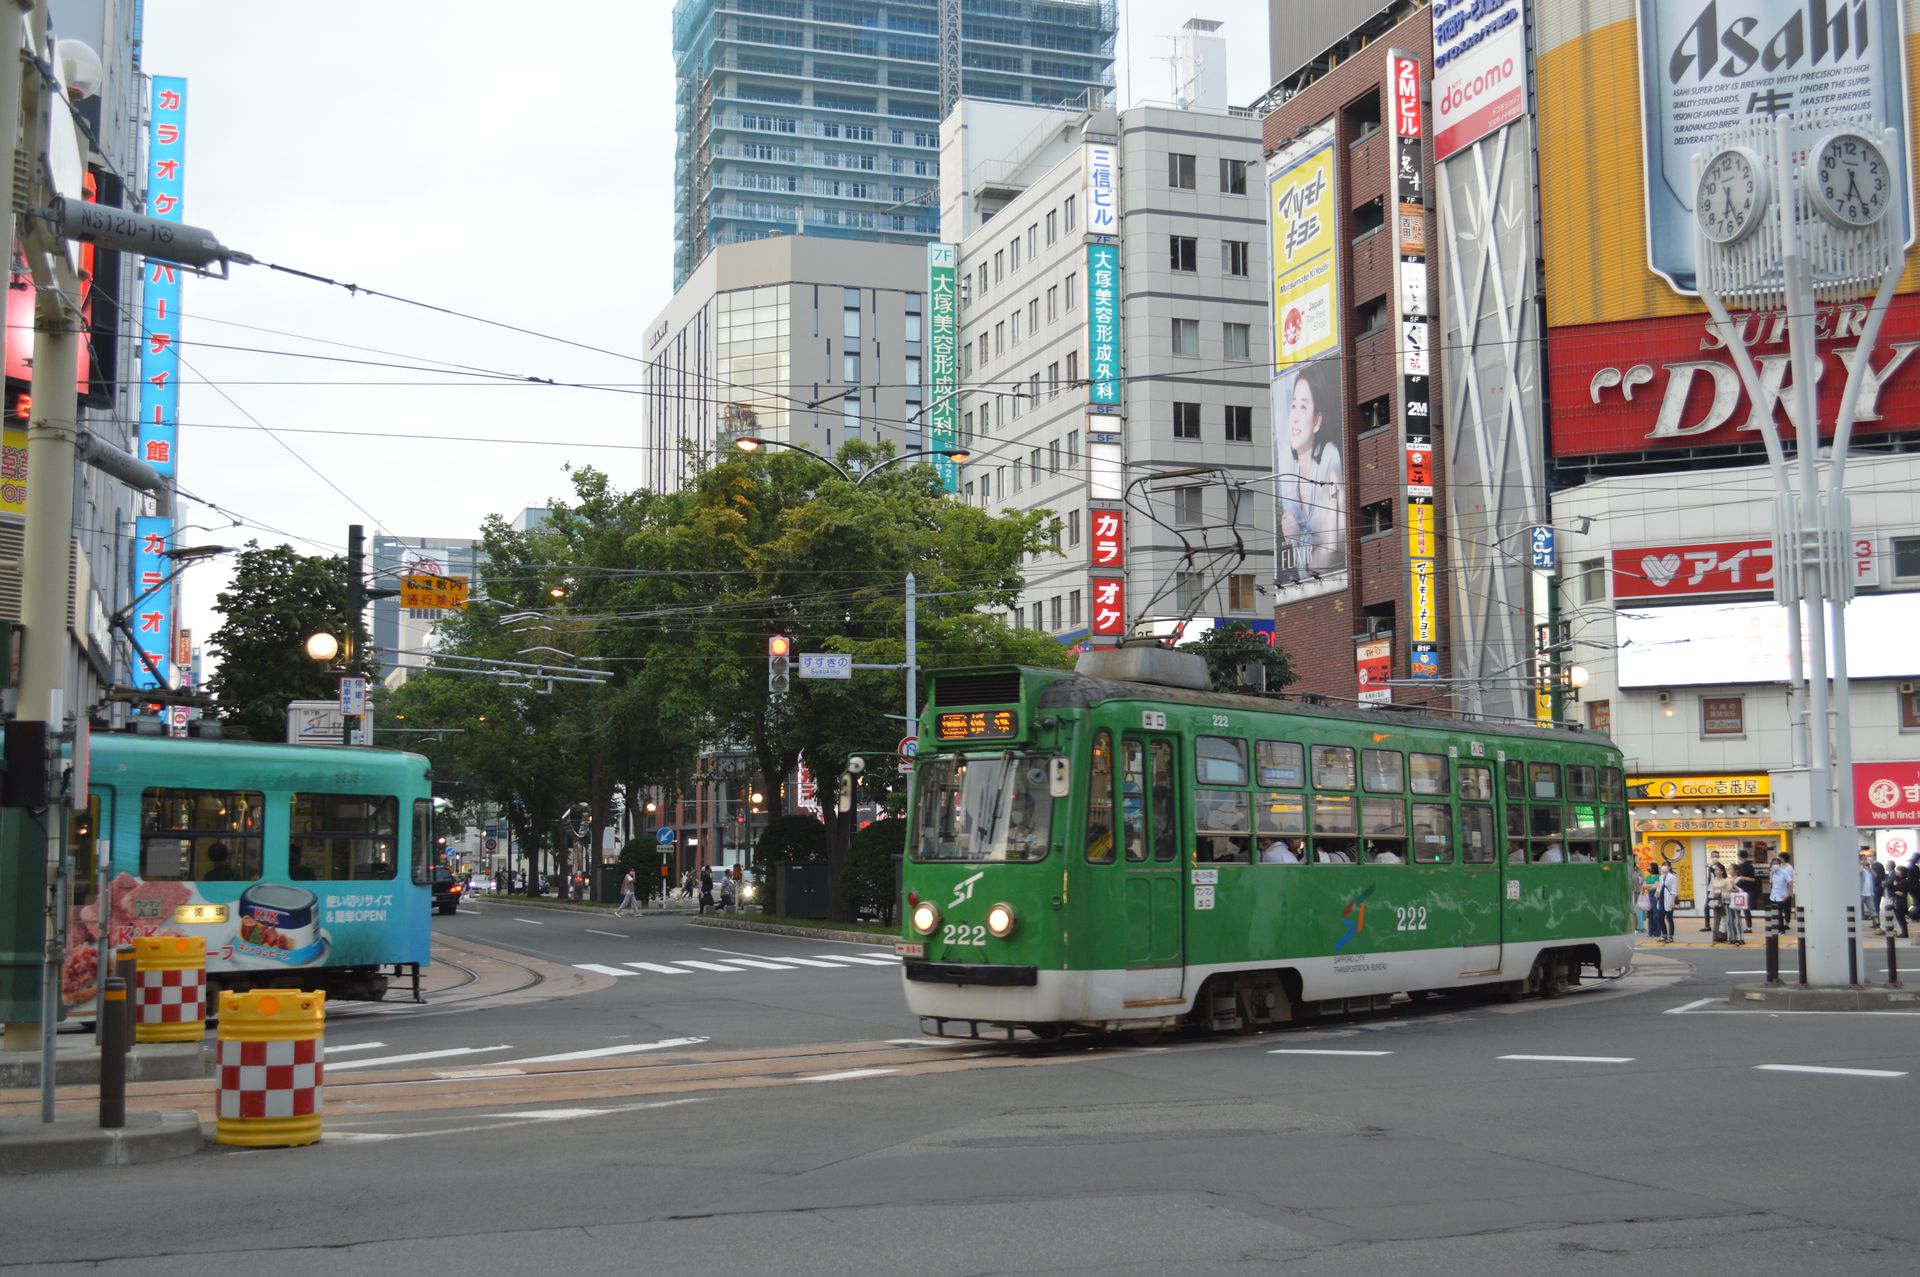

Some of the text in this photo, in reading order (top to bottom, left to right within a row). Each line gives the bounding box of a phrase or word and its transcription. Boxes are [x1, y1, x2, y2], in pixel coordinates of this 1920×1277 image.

[1669, 0, 1868, 84] Asahi
[1441, 58, 1513, 115] docomo
[1672, 88, 1690, 98] ASAHI
[1690, 84, 1712, 95] SUPER
[1714, 83, 1730, 92] DRY
[1731, 82, 1739, 90] IS
[1740, 78, 1775, 89] BREWED
[1776, 75, 1799, 85] WITH
[1800, 68, 1842, 82] PRECISION
[1843, 66, 1852, 75] TO
[1799, 82, 1829, 94] UNDER
[1830, 80, 1847, 89] THE
[1399, 60, 1418, 136] 2Mビル
[1800, 89, 1871, 106] MASTER BREWERS
[1672, 101, 1695, 109] QUALITY
[1672, 112, 1693, 121] VISION
[1702, 107, 1739, 118] JAPANESE
[1673, 124, 1685, 133] OUR
[1685, 122, 1718, 132] ADVANCED
[1674, 136, 1698, 145] DELIVER
[1831, 145, 1842, 157] 11
[1844, 143, 1856, 155] 12
[1824, 156, 1836, 168] 10
[1861, 150, 1867, 162] 1
[1870, 162, 1878, 174] 2
[1821, 170, 1829, 182] 9
[1092, 149, 1113, 226] 三信ビル
[1874, 179, 1882, 191] 3
[1278, 169, 1326, 219] マツモト
[1826, 186, 1834, 199] 8
[1870, 193, 1878, 205] 4
[1837, 200, 1844, 211] 7
[1849, 205, 1856, 218] 6
[1095, 234, 1112, 243] 7F
[1285, 215, 1320, 260] キヨシ
[933, 249, 953, 261] 7F
[1280, 271, 1308, 295] Matsumoto
[1093, 250, 1114, 400] 大塚美容形成外科
[933, 274, 954, 437] 大塚美容形成外科
[1096, 405, 1114, 413] 5F
[1097, 434, 1114, 442] 5F
[804, 657, 848, 667] すすきの
[1212, 714, 1229, 727] 222
[1682, 779, 1757, 796] CoCo壱番屋
[1897, 810, 1915, 819] find
[1674, 820, 1749, 830] お持ち帰りできます
[326, 894, 392, 908] 使い切りサイズ
[1397, 906, 1427, 931] 222
[943, 924, 987, 946] 222
